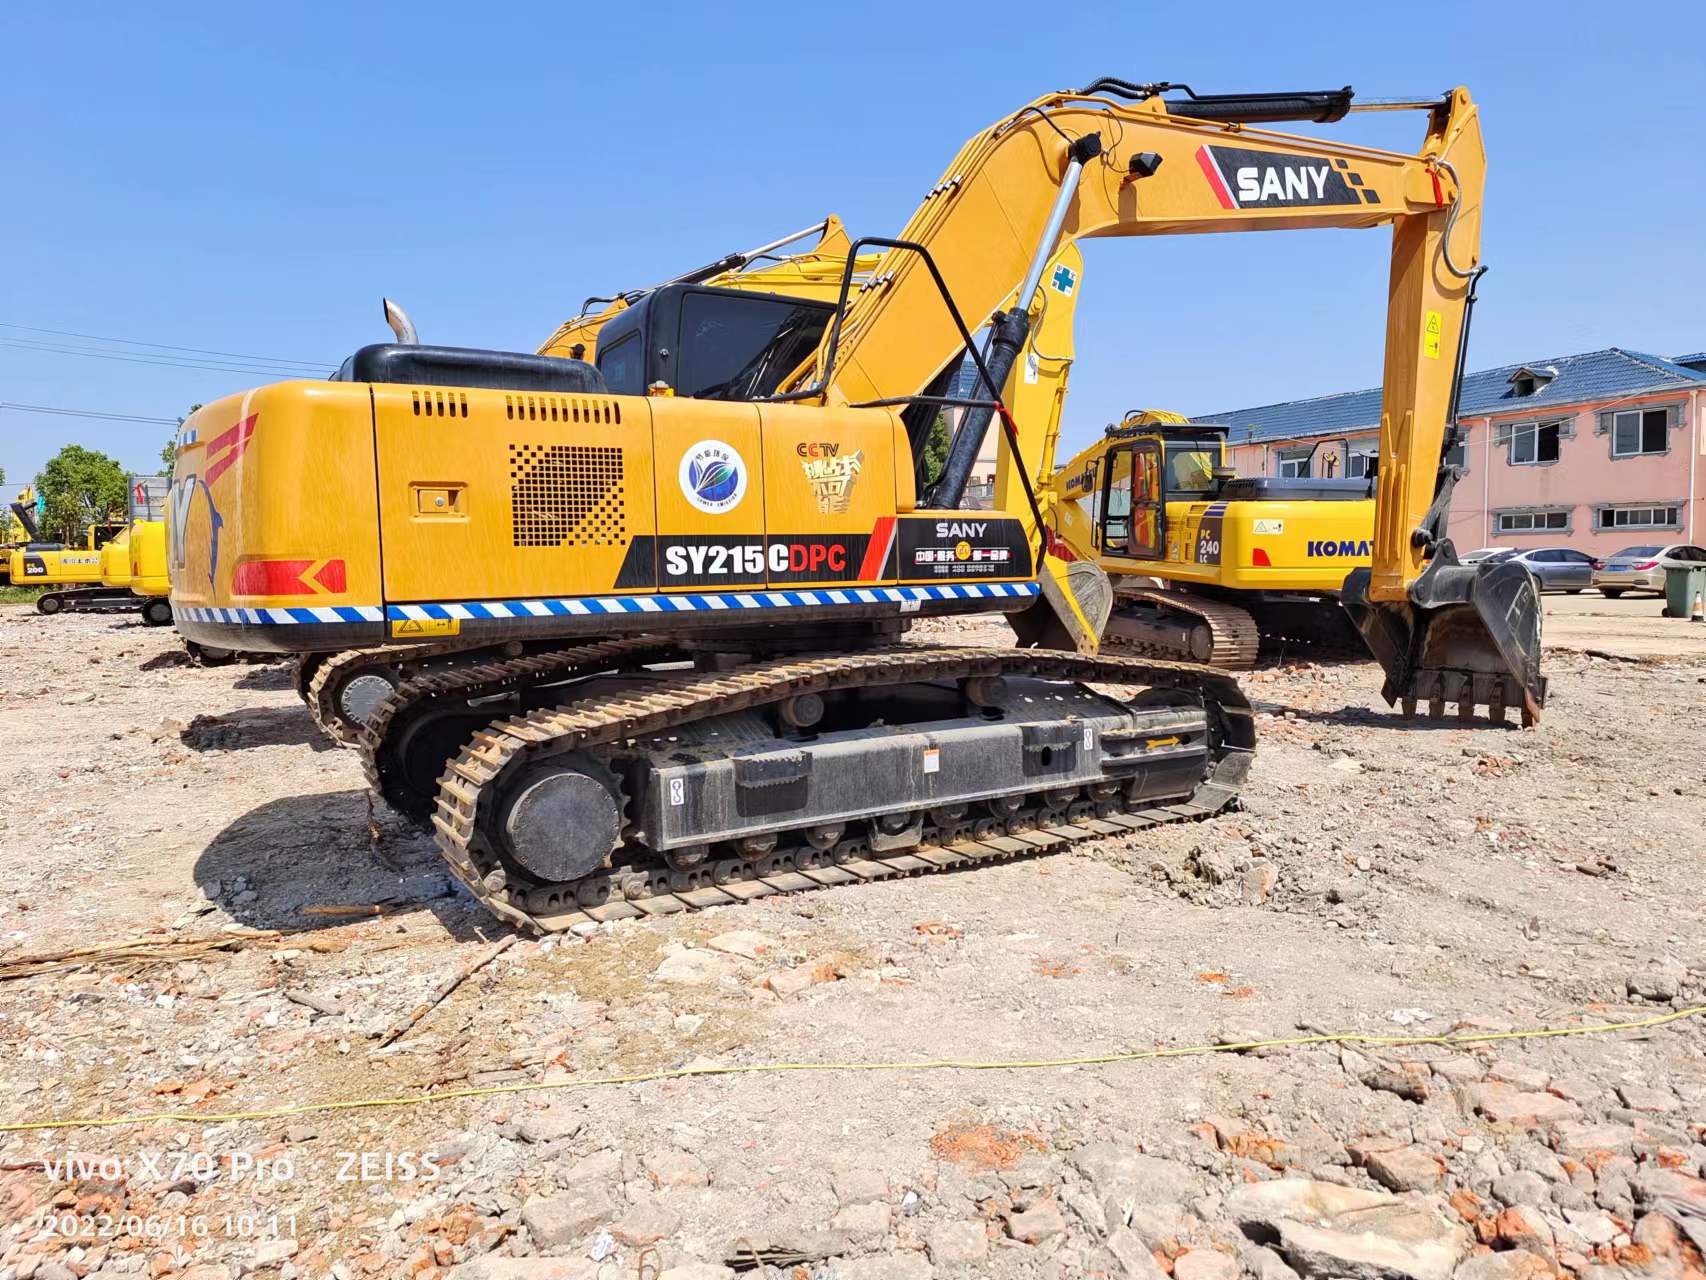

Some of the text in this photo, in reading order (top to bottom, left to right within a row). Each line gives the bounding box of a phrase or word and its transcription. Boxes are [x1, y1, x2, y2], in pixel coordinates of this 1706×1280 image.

[1236, 166, 1330, 202] SANY
[796, 442, 840, 457] CCTV
[936, 523, 988, 538] SANY
[1200, 529, 1211, 540] PC
[1199, 540, 1220, 555] 240
[1307, 540, 1375, 557] KOMA
[665, 543, 847, 576] SY215CDPC
[1199, 554, 1209, 564] LC
[27, 566, 44, 574] 200
